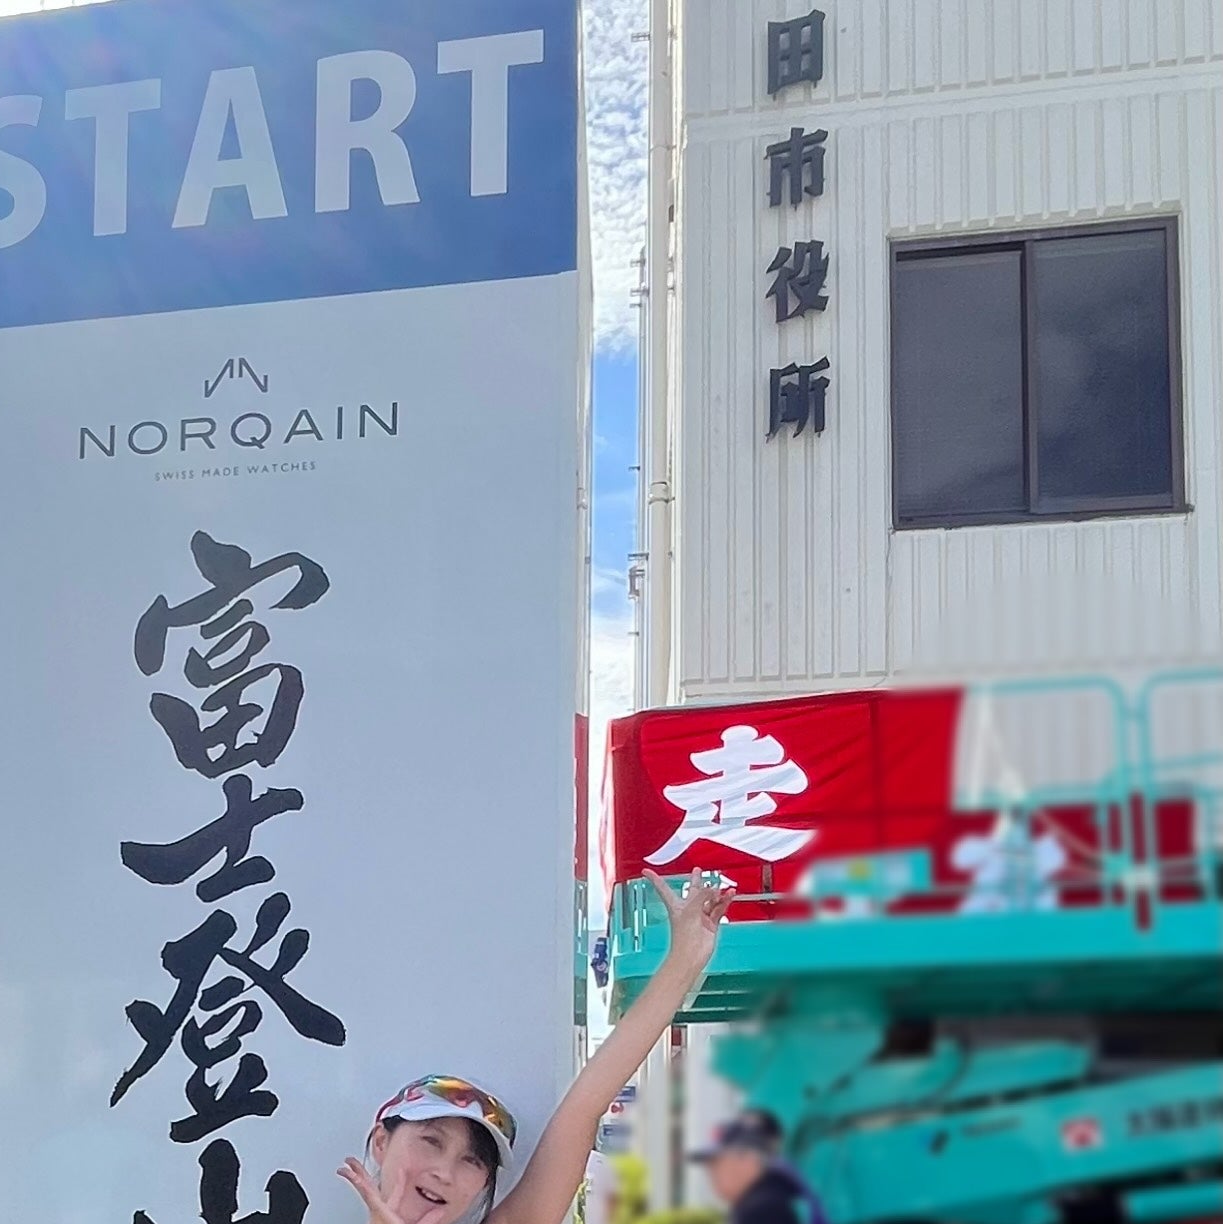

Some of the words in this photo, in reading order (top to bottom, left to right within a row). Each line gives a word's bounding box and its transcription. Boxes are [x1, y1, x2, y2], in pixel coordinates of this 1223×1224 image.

[765, 8, 831, 444] 田市役所
[78, 401, 399, 460] NORQAIN
[154, 469, 195, 482] SWISS
[201, 465, 240, 478] MADE
[247, 460, 317, 475] WATCHES
[642, 724, 819, 866] 走
